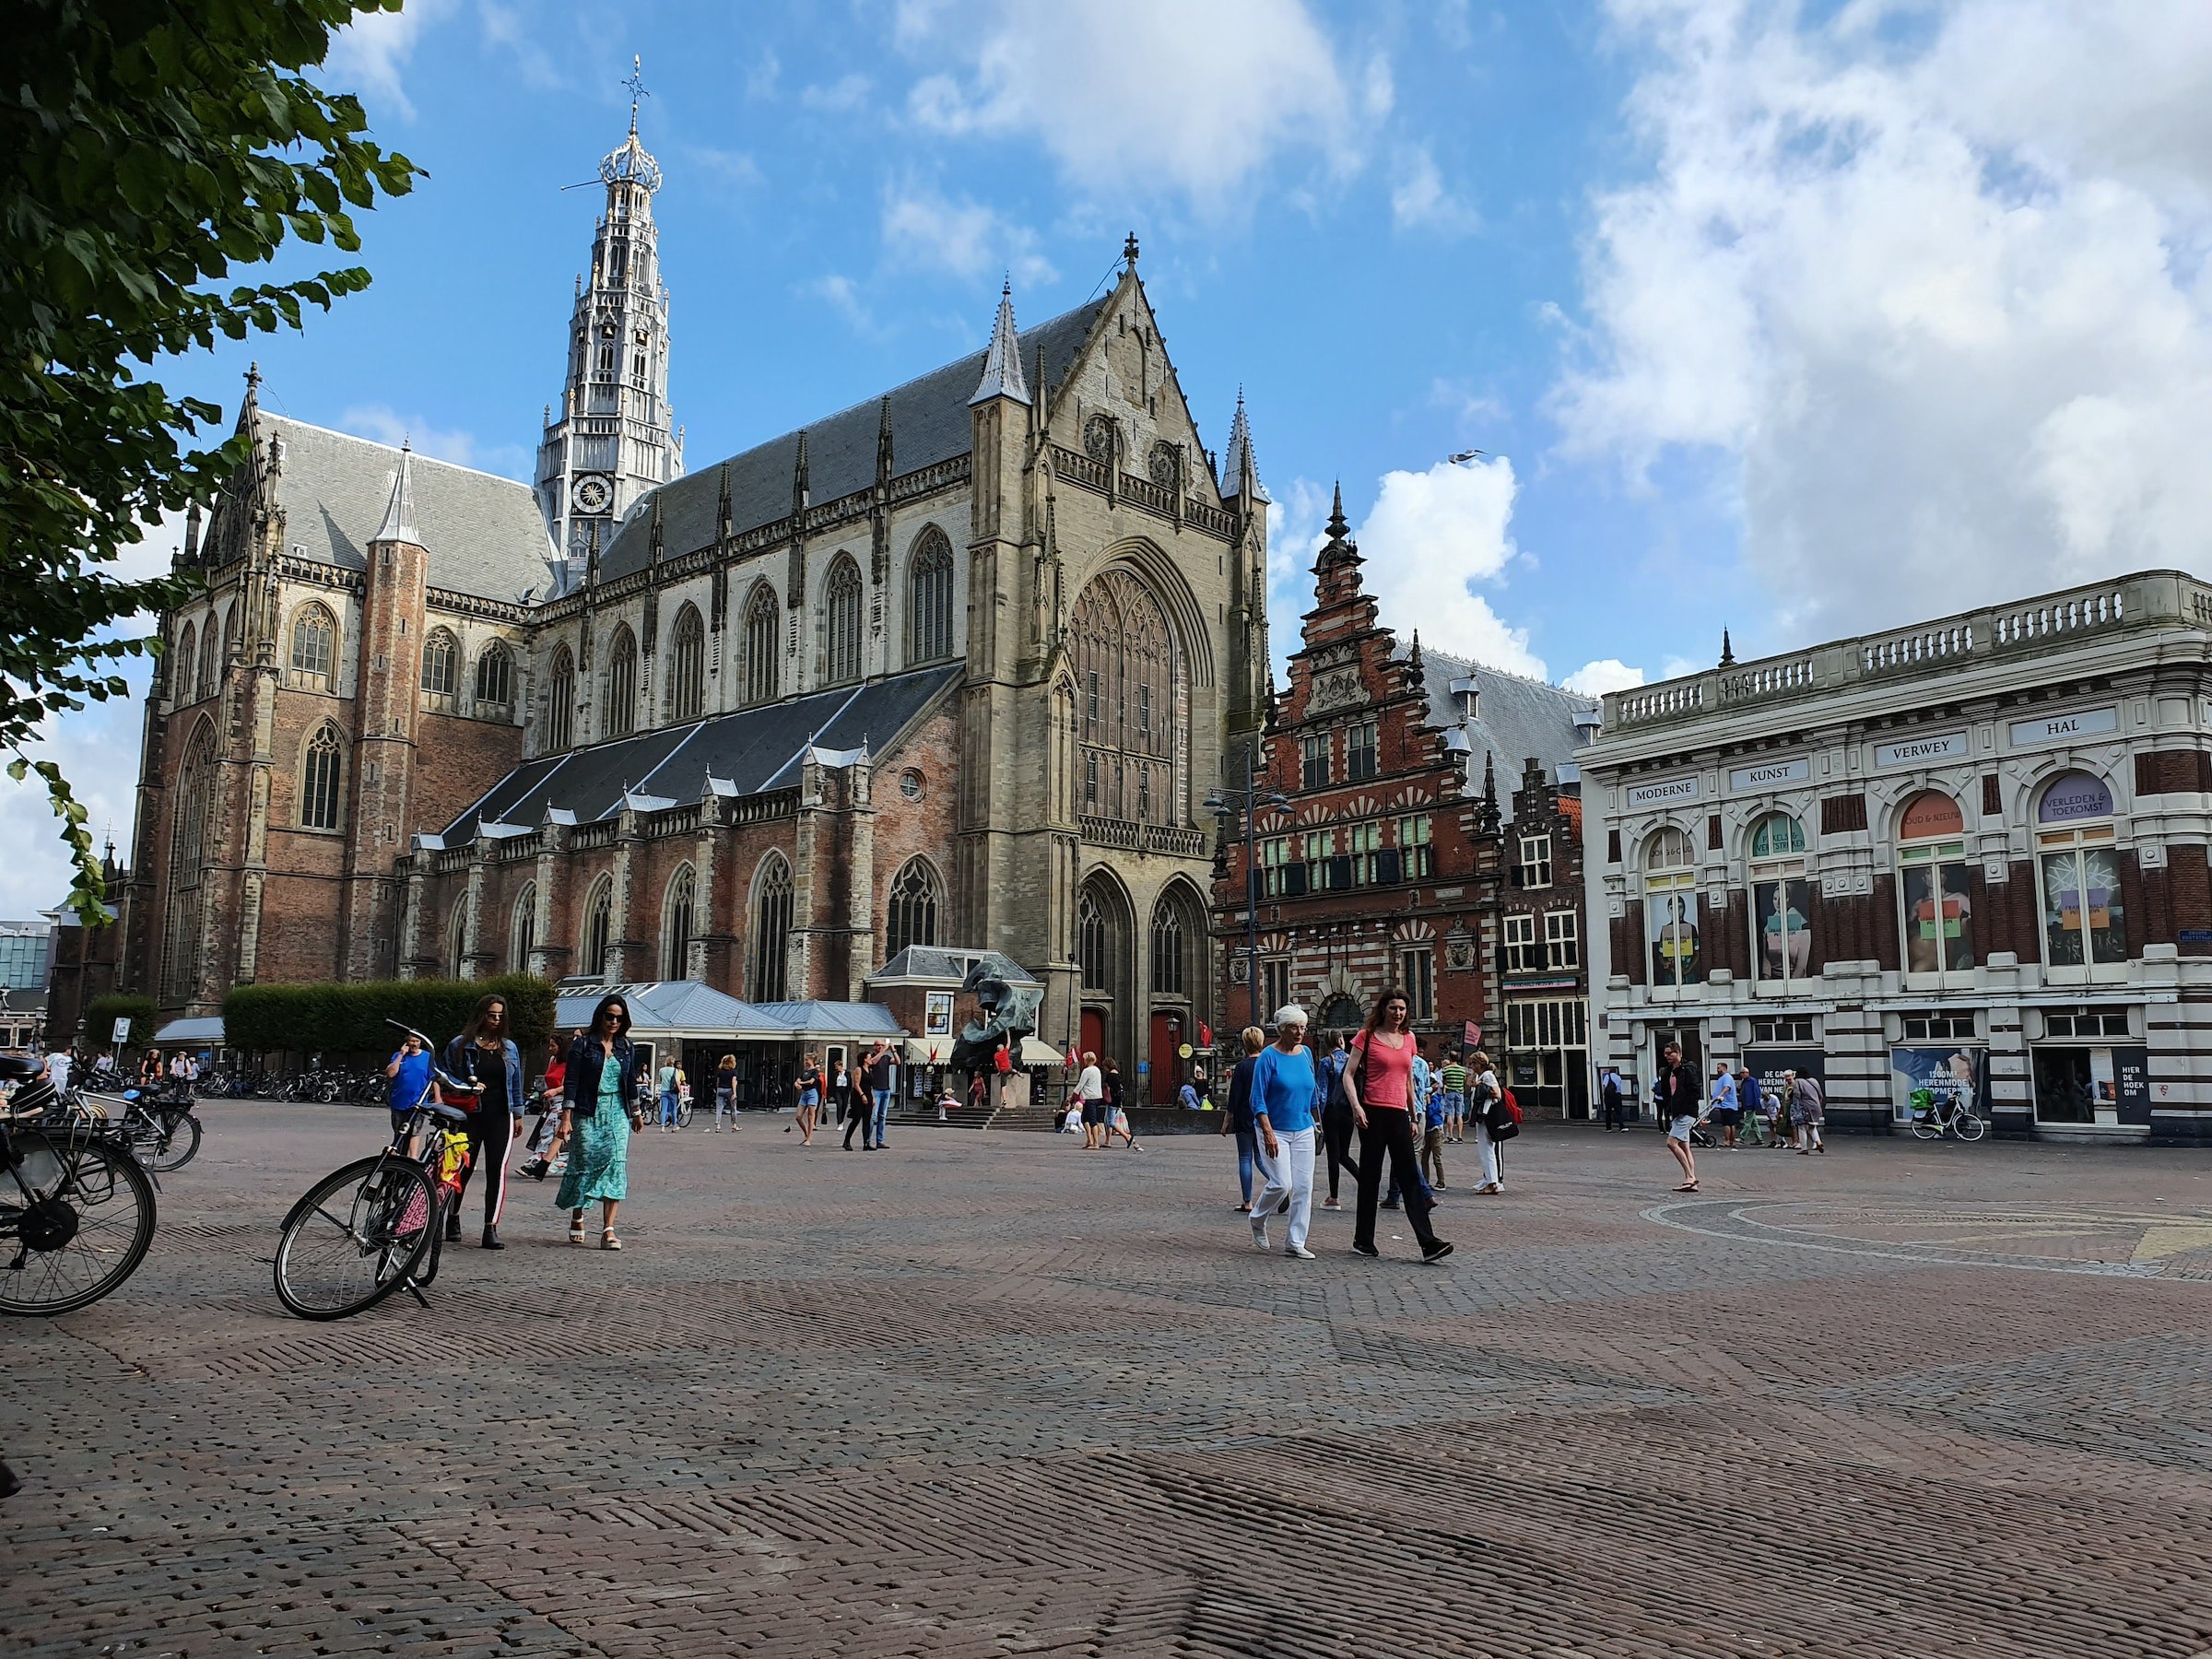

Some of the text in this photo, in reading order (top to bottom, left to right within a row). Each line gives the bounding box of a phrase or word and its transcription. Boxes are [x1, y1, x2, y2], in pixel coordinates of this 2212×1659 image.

[1893, 719, 2079, 759] VERWEY HAL
[1636, 767, 1790, 801] MODERNE KUNST
[2046, 793, 2106, 807] VERLEDEN &
[2052, 803, 2102, 816] TOEKOMST
[1905, 811, 1960, 825] OUD & NIEUW
